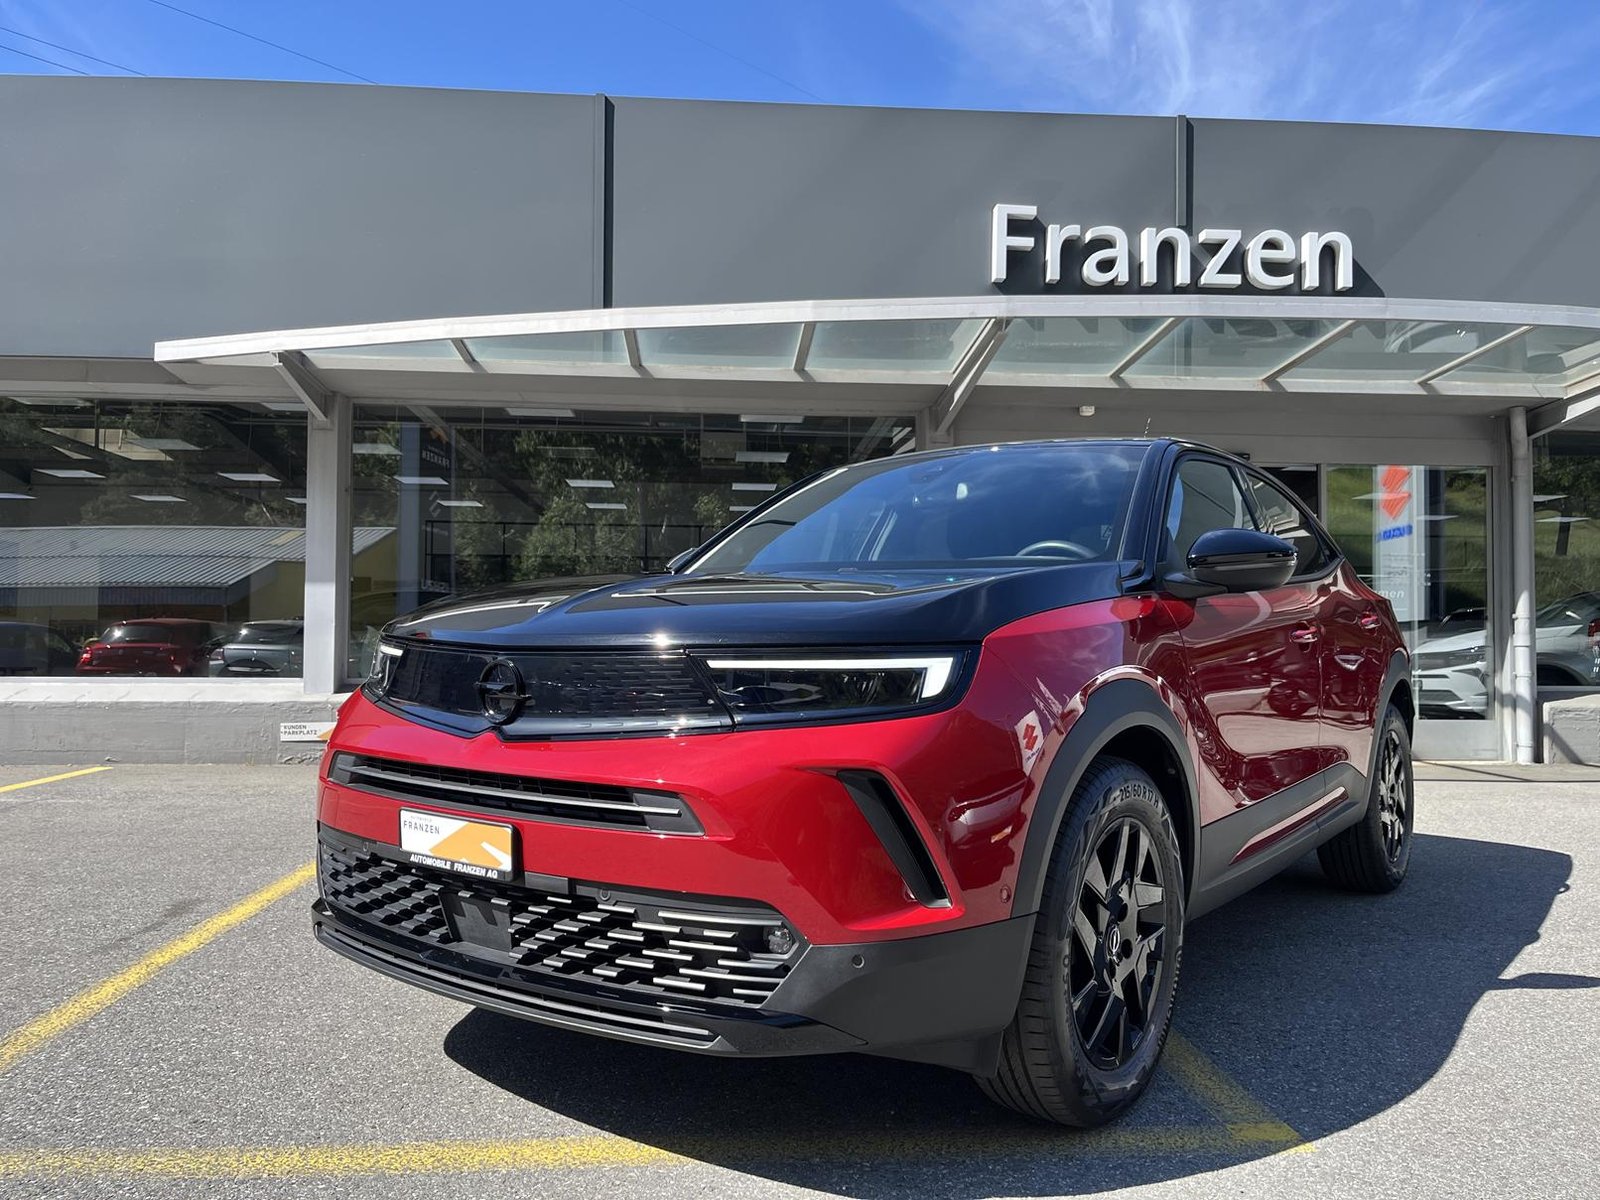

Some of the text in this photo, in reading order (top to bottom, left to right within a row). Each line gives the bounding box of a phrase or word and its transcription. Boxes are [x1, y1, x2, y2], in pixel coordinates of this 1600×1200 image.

[991, 203, 1353, 291] Franzen
[403, 820, 440, 834] FRANZEN
[410, 854, 452, 869] AUTOMOBILE
[453, 863, 486, 877] FRANZEN
